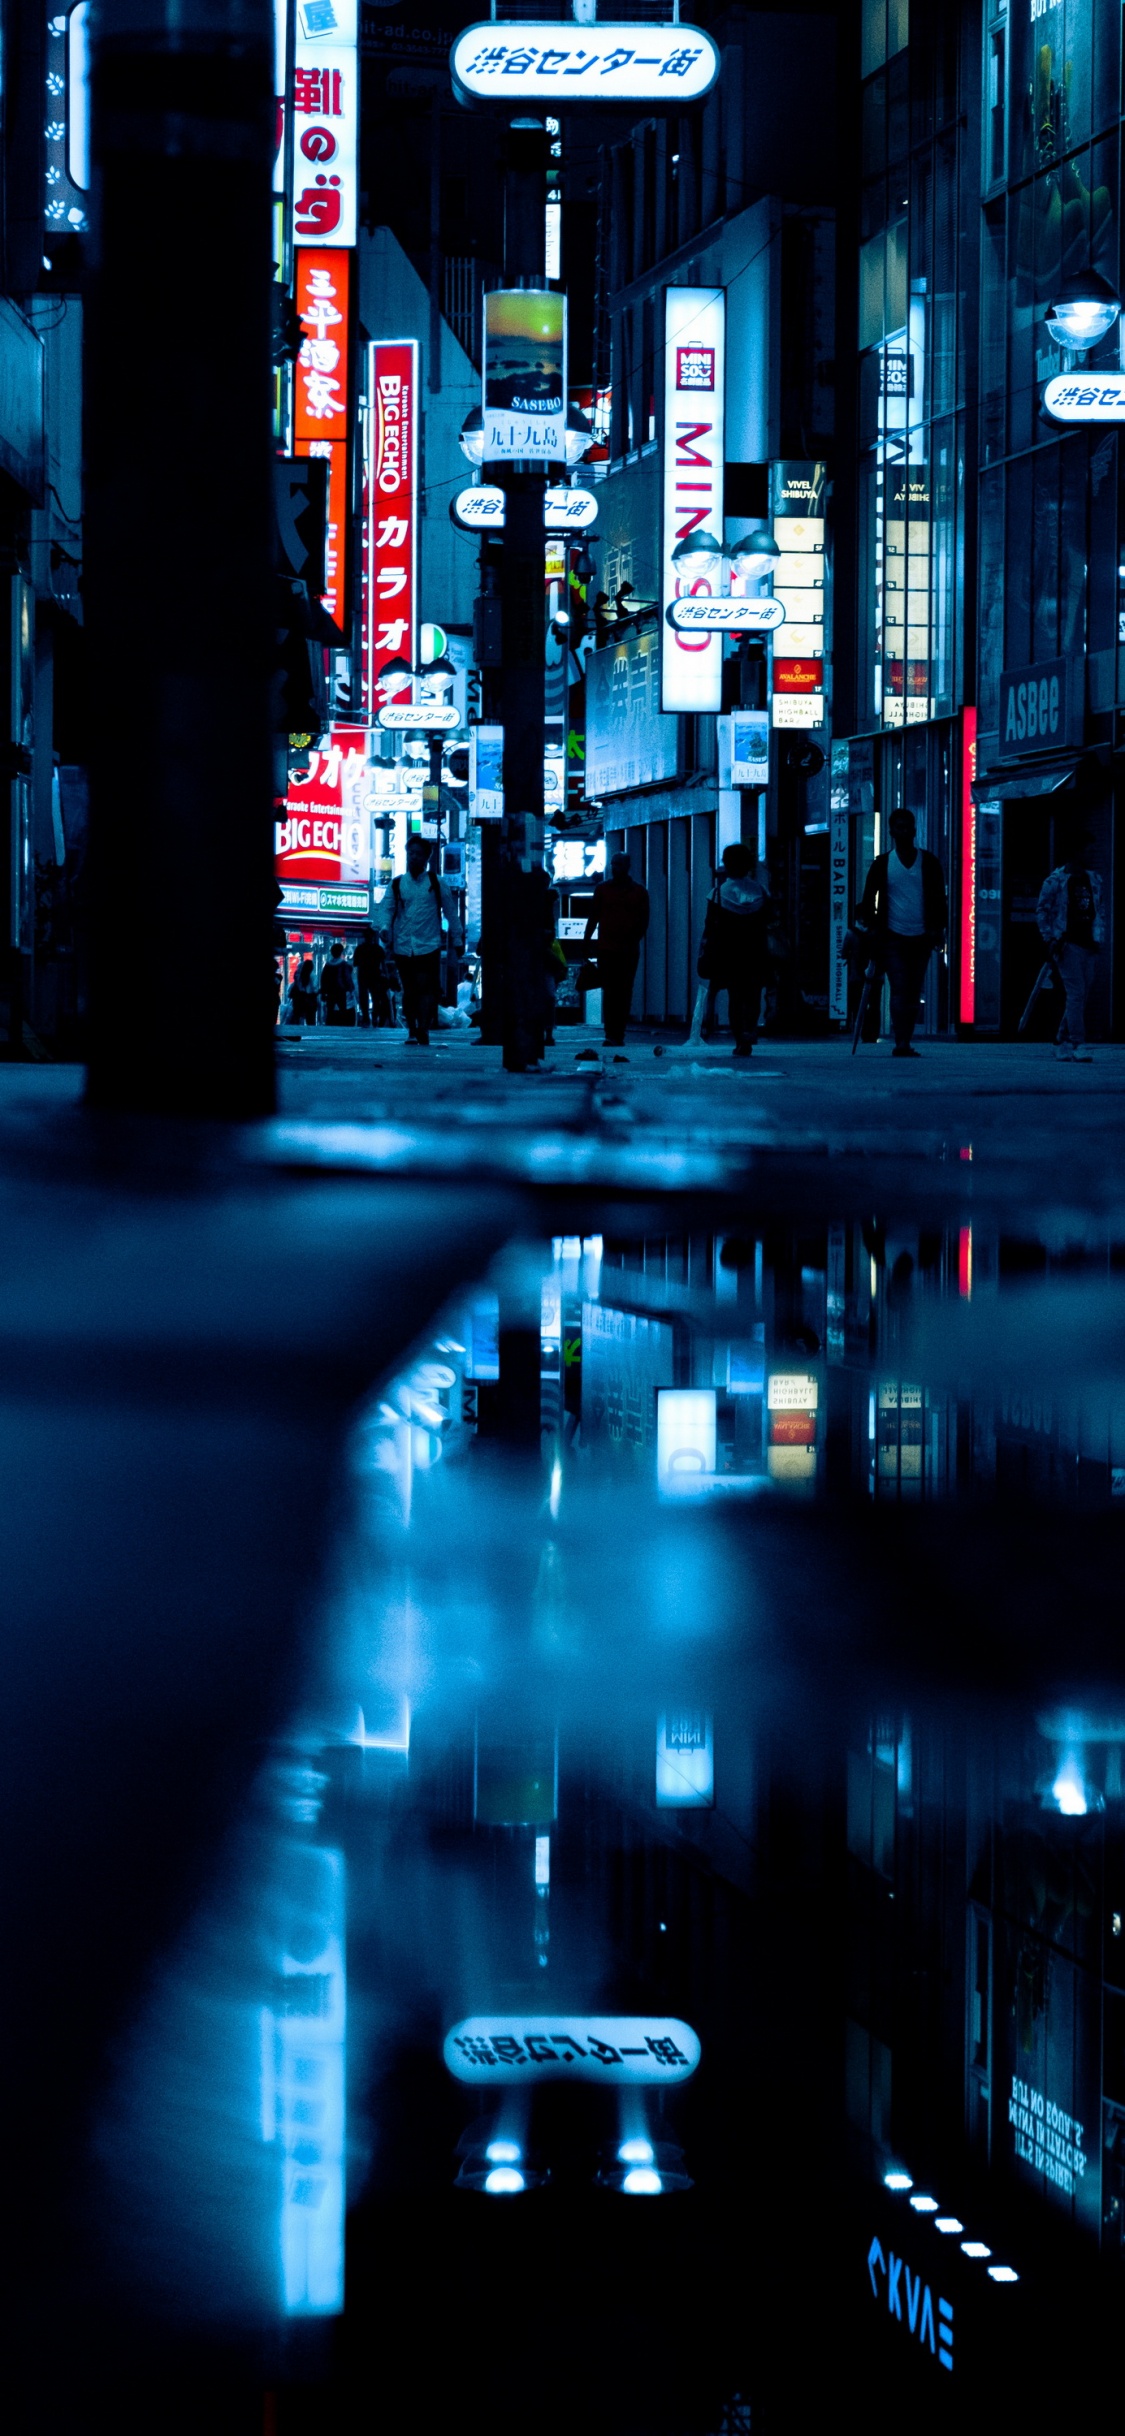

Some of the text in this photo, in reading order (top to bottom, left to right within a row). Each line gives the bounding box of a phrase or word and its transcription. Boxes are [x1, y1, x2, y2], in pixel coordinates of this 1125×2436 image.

[465, 46, 703, 77] 渋谷センター街
[680, 353, 711, 365] MINI
[511, 396, 561, 411] SASEBO
[1052, 387, 1125, 405] 渋谷セ
[378, 375, 401, 493] BIG ECHO
[490, 426, 558, 448] 九十九島
[781, 489, 818, 499] SHIBUYA
[787, 480, 812, 490] VIVEL
[677, 607, 778, 620] 渋谷センター街
[1005, 676, 1059, 742] ASBee
[275, 817, 311, 856] BIG
[313, 821, 365, 861] ECHO
